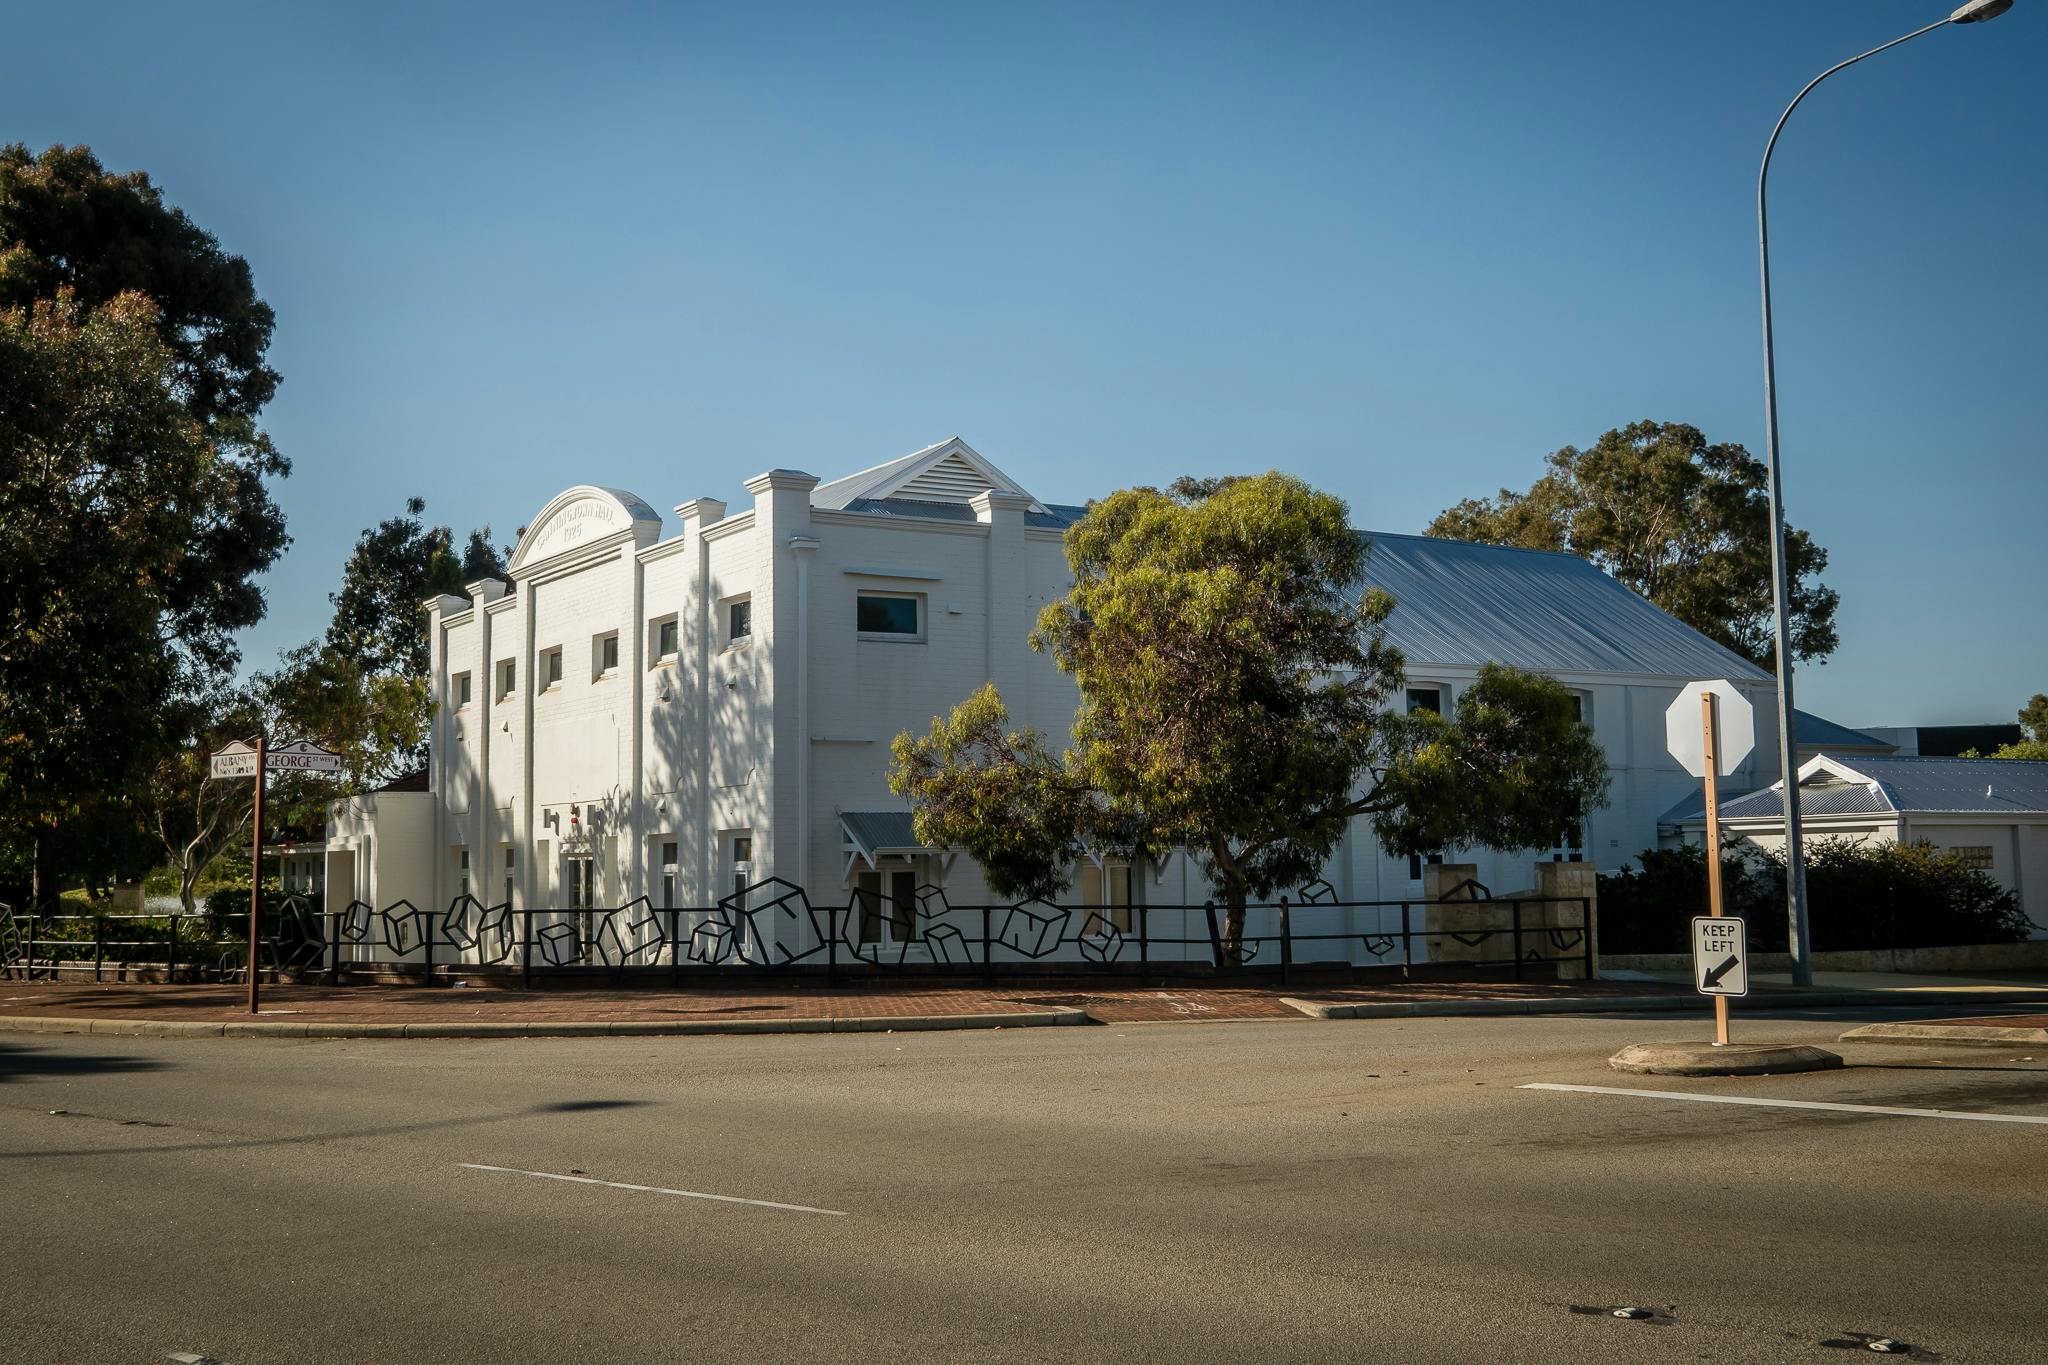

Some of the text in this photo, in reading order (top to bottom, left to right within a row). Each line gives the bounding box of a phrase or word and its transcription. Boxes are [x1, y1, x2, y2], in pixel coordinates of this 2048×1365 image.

[220, 755, 248, 767] ALBANY
[266, 754, 312, 768] GEORGE
[1702, 924, 1735, 937] KEEP
[1704, 940, 1735, 953] LEFT
